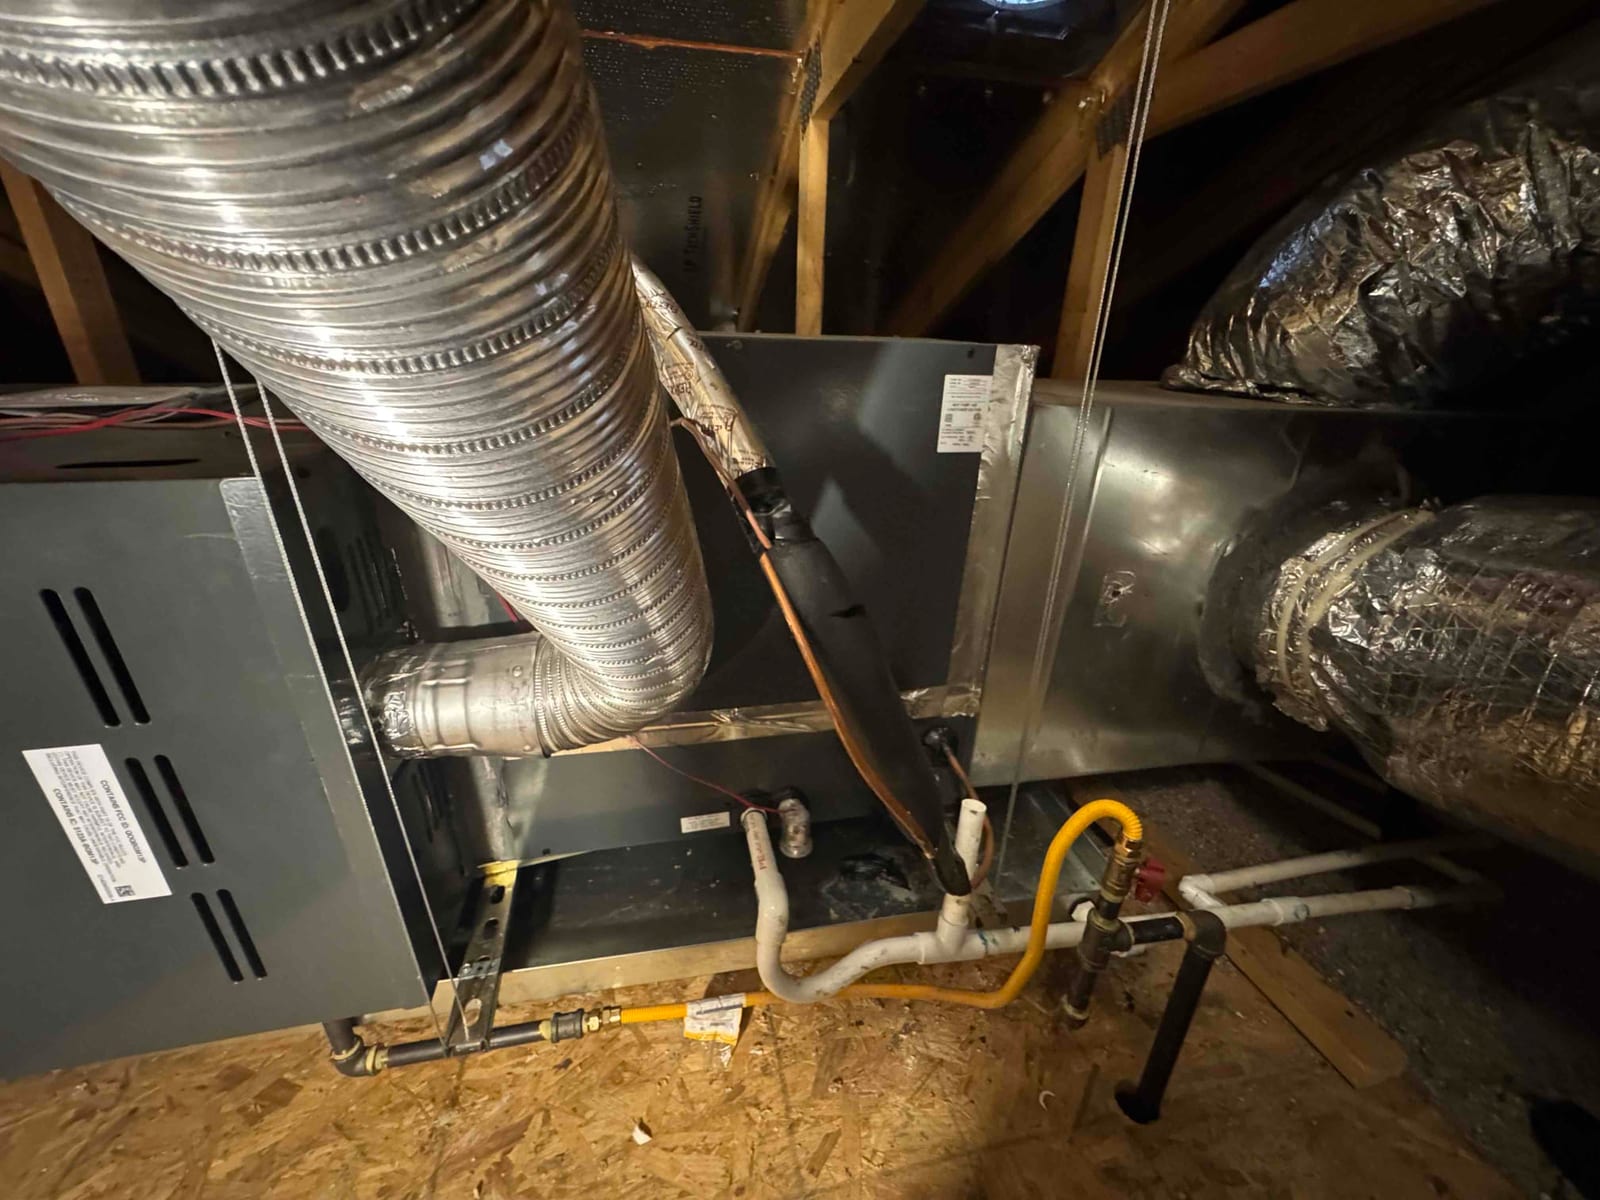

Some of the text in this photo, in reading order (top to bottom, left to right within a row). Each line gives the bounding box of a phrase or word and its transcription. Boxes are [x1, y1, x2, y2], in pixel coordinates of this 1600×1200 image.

[53, 788, 74, 817] CONTAINS
[100, 779, 120, 808] CONTAINS
[114, 808, 126, 820] FCC
